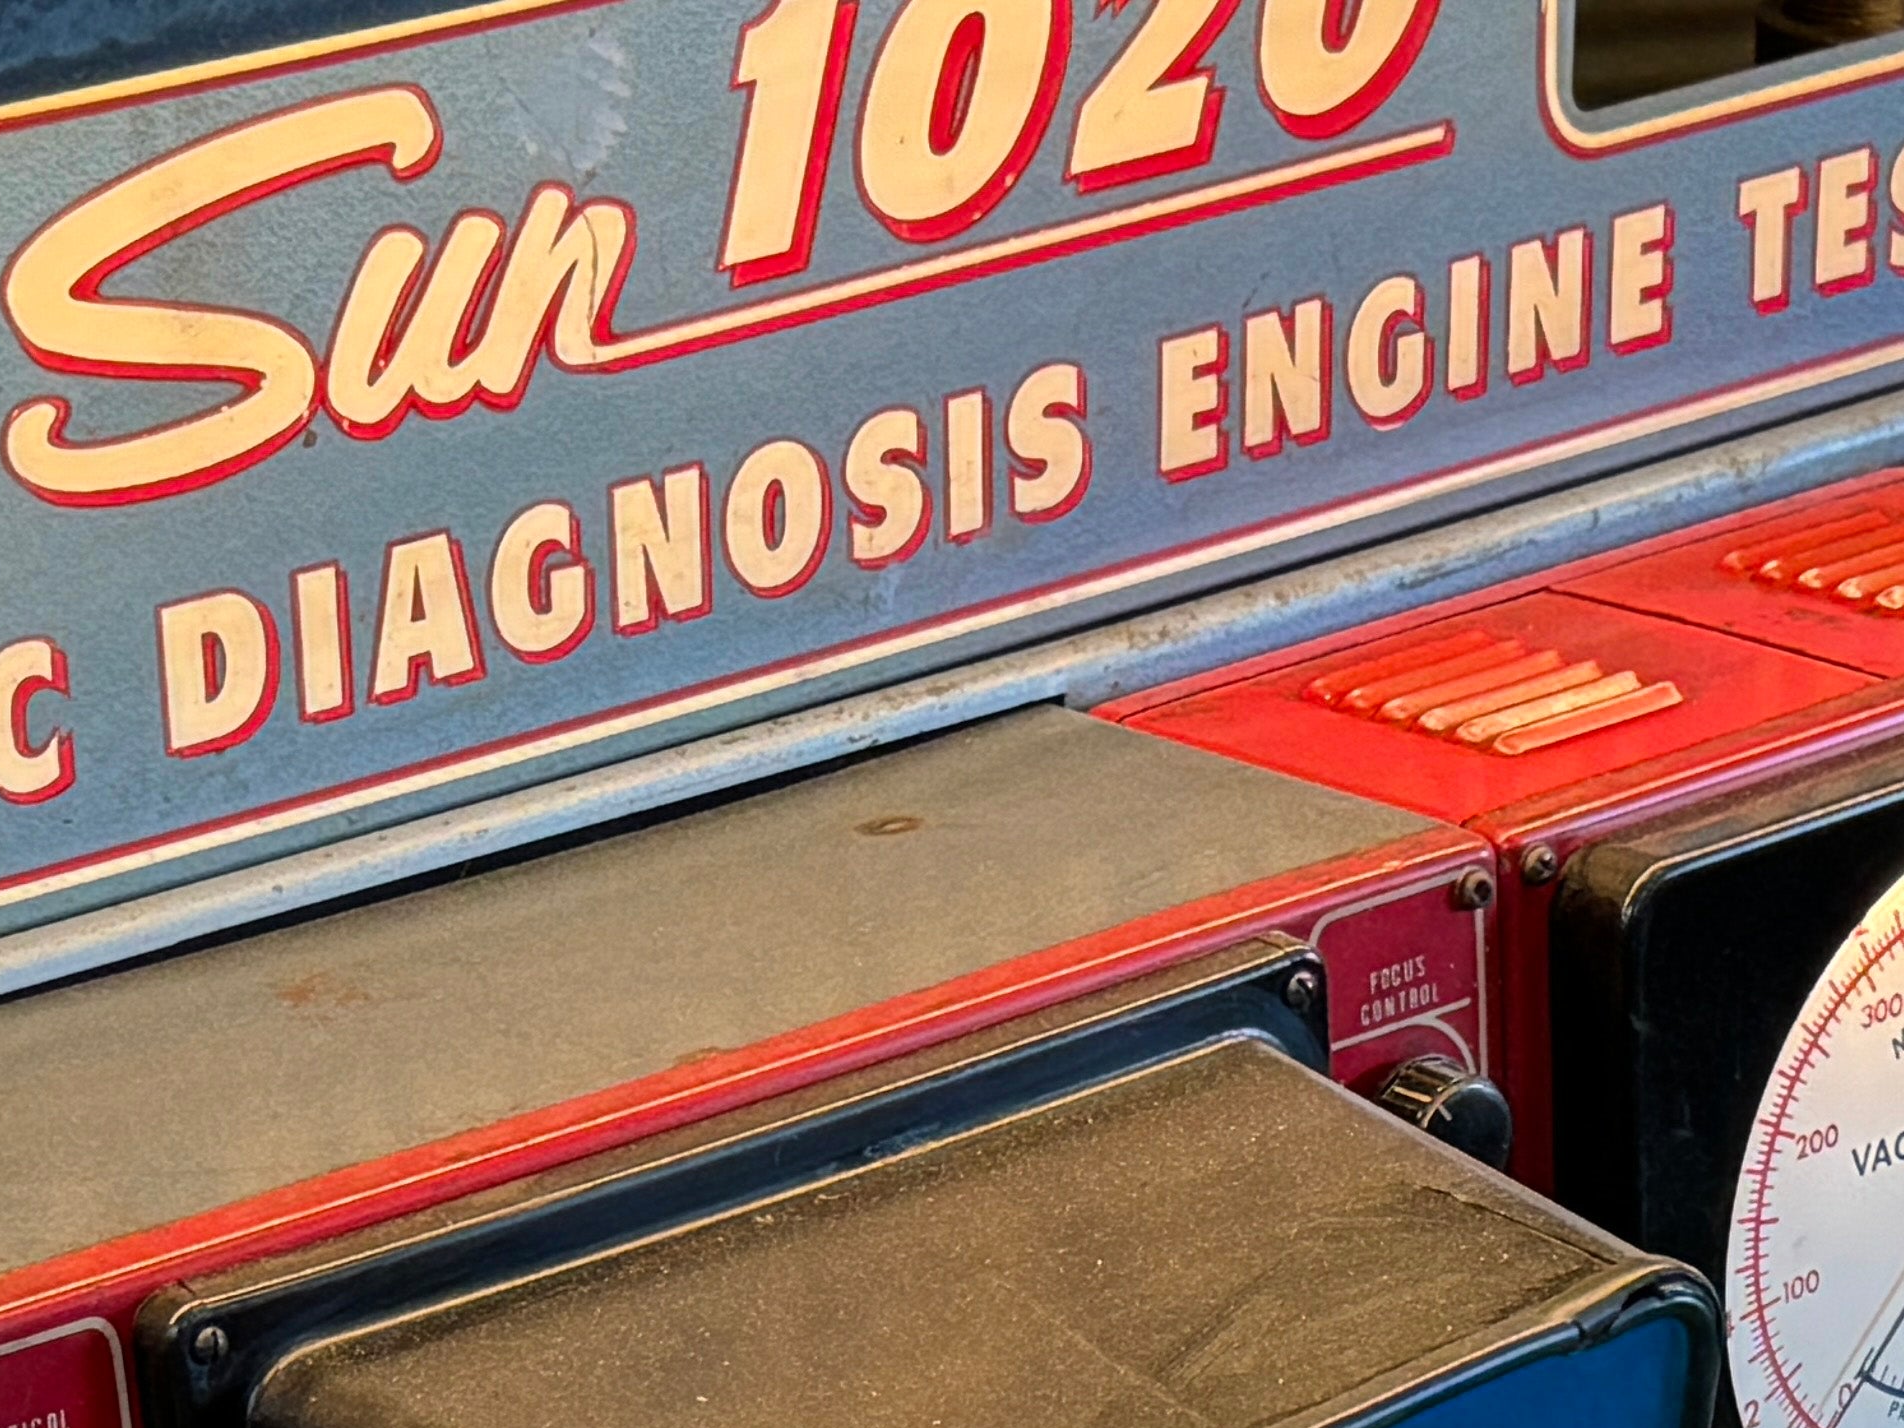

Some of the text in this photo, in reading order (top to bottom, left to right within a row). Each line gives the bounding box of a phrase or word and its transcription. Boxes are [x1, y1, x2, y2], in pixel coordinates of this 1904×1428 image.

[156, 360, 1091, 762] DIAGNOSIS
[1158, 204, 1675, 482] ENGINE
[1370, 955, 1426, 994] FOCUS
[1360, 982, 1439, 1026] CONTROL
[1860, 992, 1904, 1029] 300
